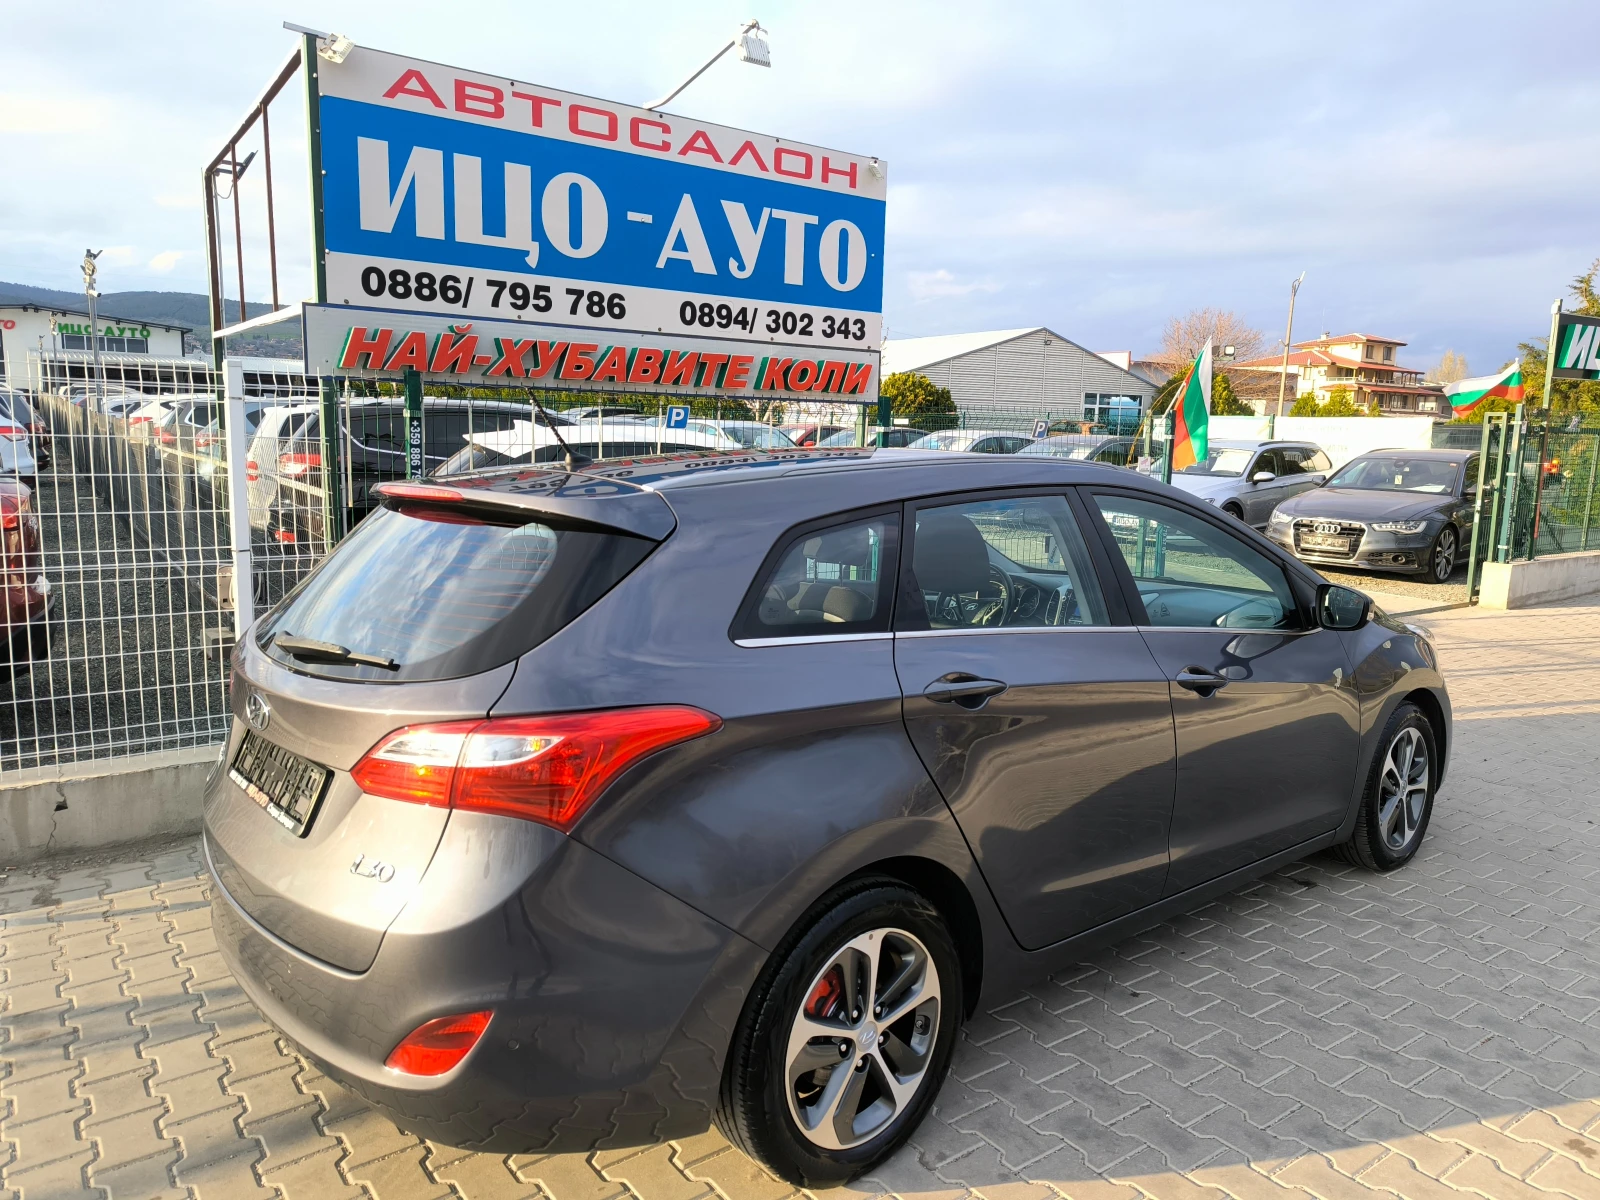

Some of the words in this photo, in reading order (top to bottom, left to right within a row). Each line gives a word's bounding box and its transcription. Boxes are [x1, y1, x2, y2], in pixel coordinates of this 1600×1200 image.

[382, 68, 857, 189] АВТОСАЛОН
[486, 279, 552, 313] 795
[565, 288, 626, 320] 786
[766, 310, 813, 336] 302
[822, 315, 866, 341] 343
[337, 323, 754, 389] НАЙ-ХУБАВИТЕ
[753, 356, 873, 394] КОЛИ
[670, 408, 685, 427] P
[1034, 421, 1046, 437] P
[410, 420, 421, 445] +359
[410, 447, 421, 466] 886
